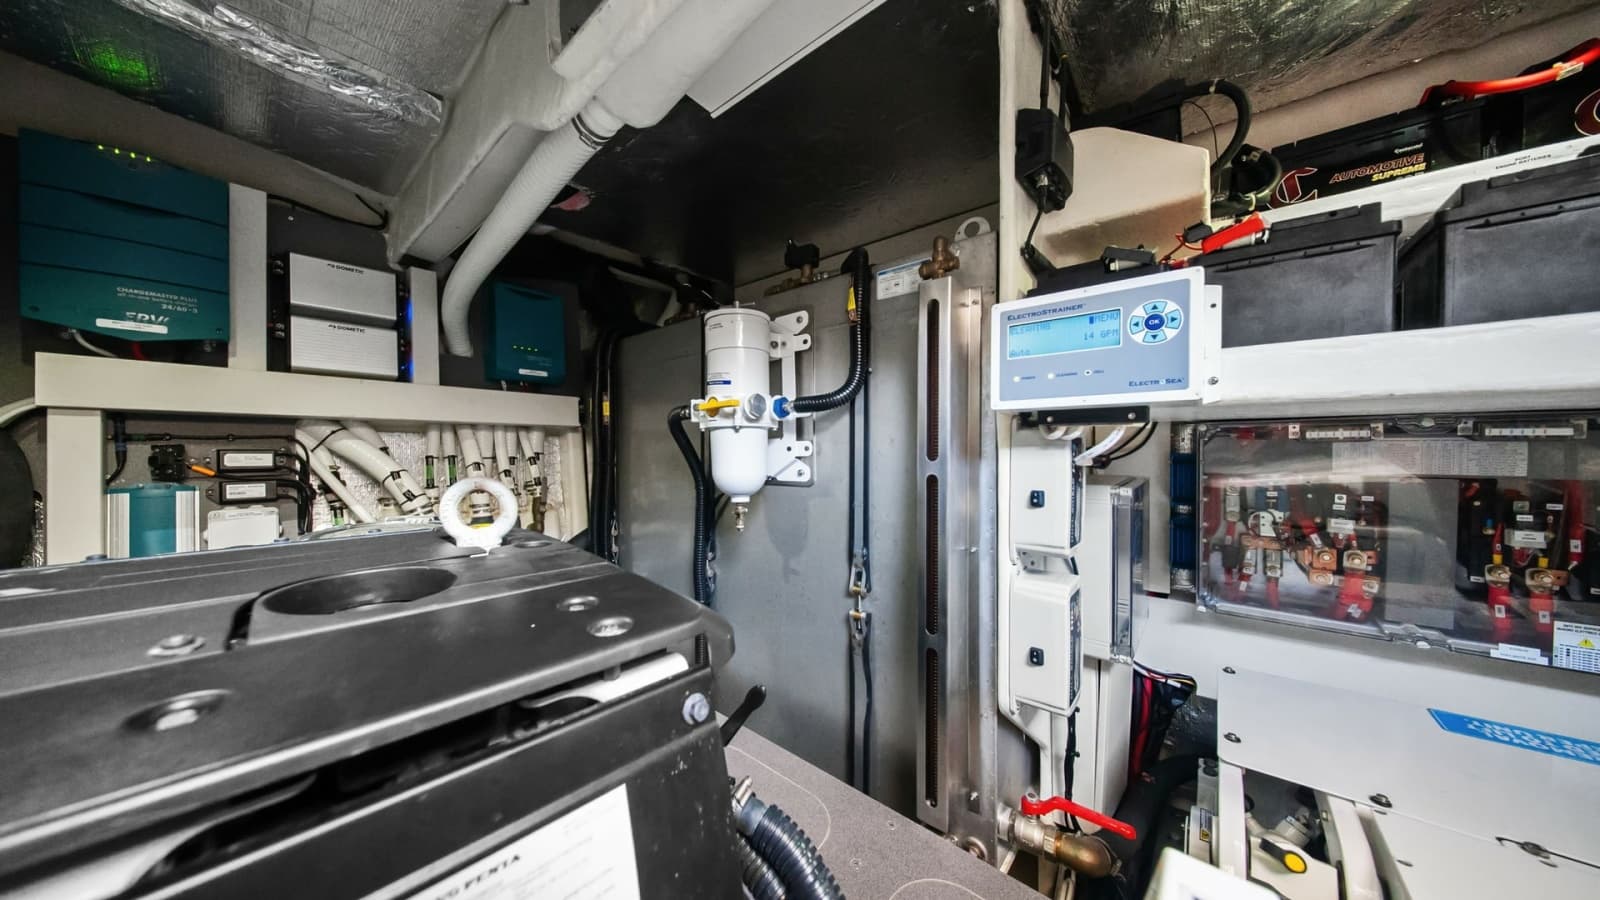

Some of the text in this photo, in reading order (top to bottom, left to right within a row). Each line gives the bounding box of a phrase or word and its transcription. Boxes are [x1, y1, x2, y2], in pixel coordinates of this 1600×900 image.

[1329, 153, 1424, 184] AUTOMOTIVE
[1371, 162, 1427, 181] SUPREME
[116, 287, 178, 300] CHARGEMASTER
[1094, 311, 1120, 323] MENU
[1083, 328, 1119, 341] 14 GPM
[463, 854, 520, 889] PENTA
